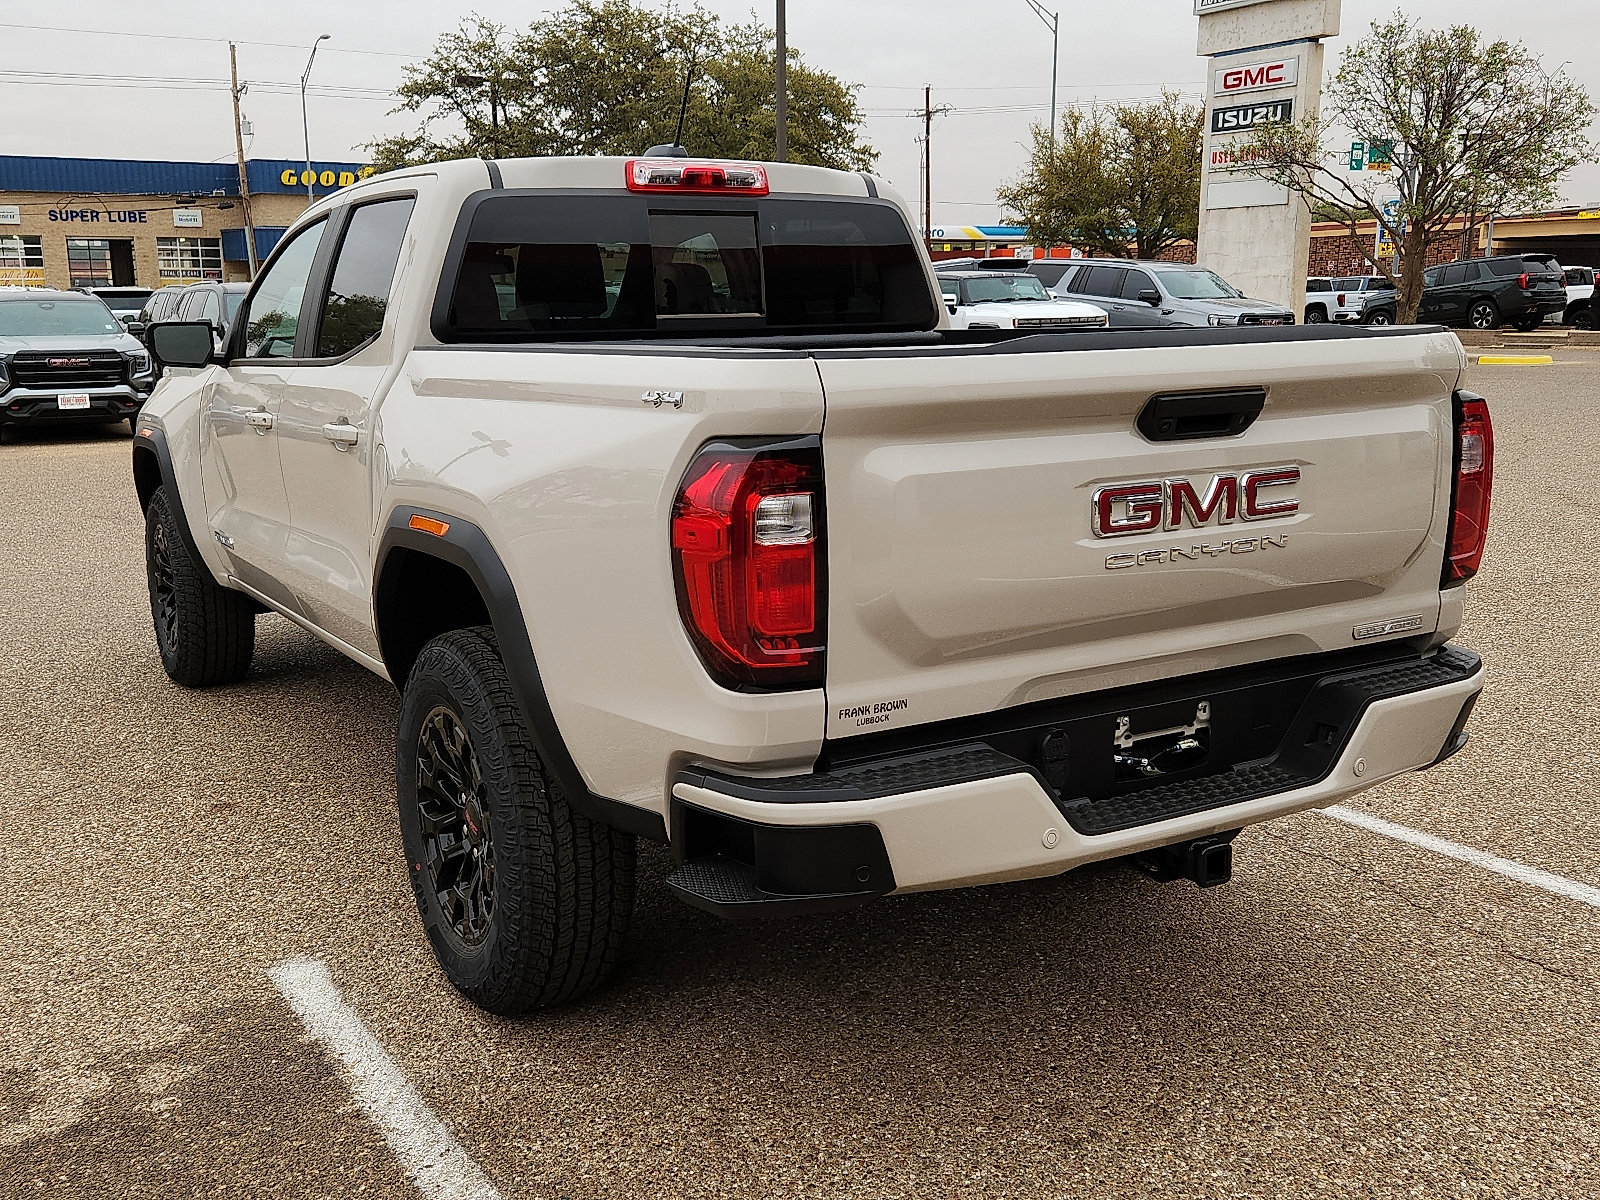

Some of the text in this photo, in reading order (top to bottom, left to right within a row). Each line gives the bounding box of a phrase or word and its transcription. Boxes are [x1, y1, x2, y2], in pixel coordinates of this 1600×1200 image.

[1223, 64, 1284, 90] GMC
[1217, 105, 1282, 128] ISUZU
[48, 209, 147, 223] SUPER LUBE
[1091, 466, 1301, 538] GMC
[1105, 533, 1289, 570] CANYON
[838, 699, 908, 720] FRANK BROWN
[856, 714, 890, 727] LUBBOCK
